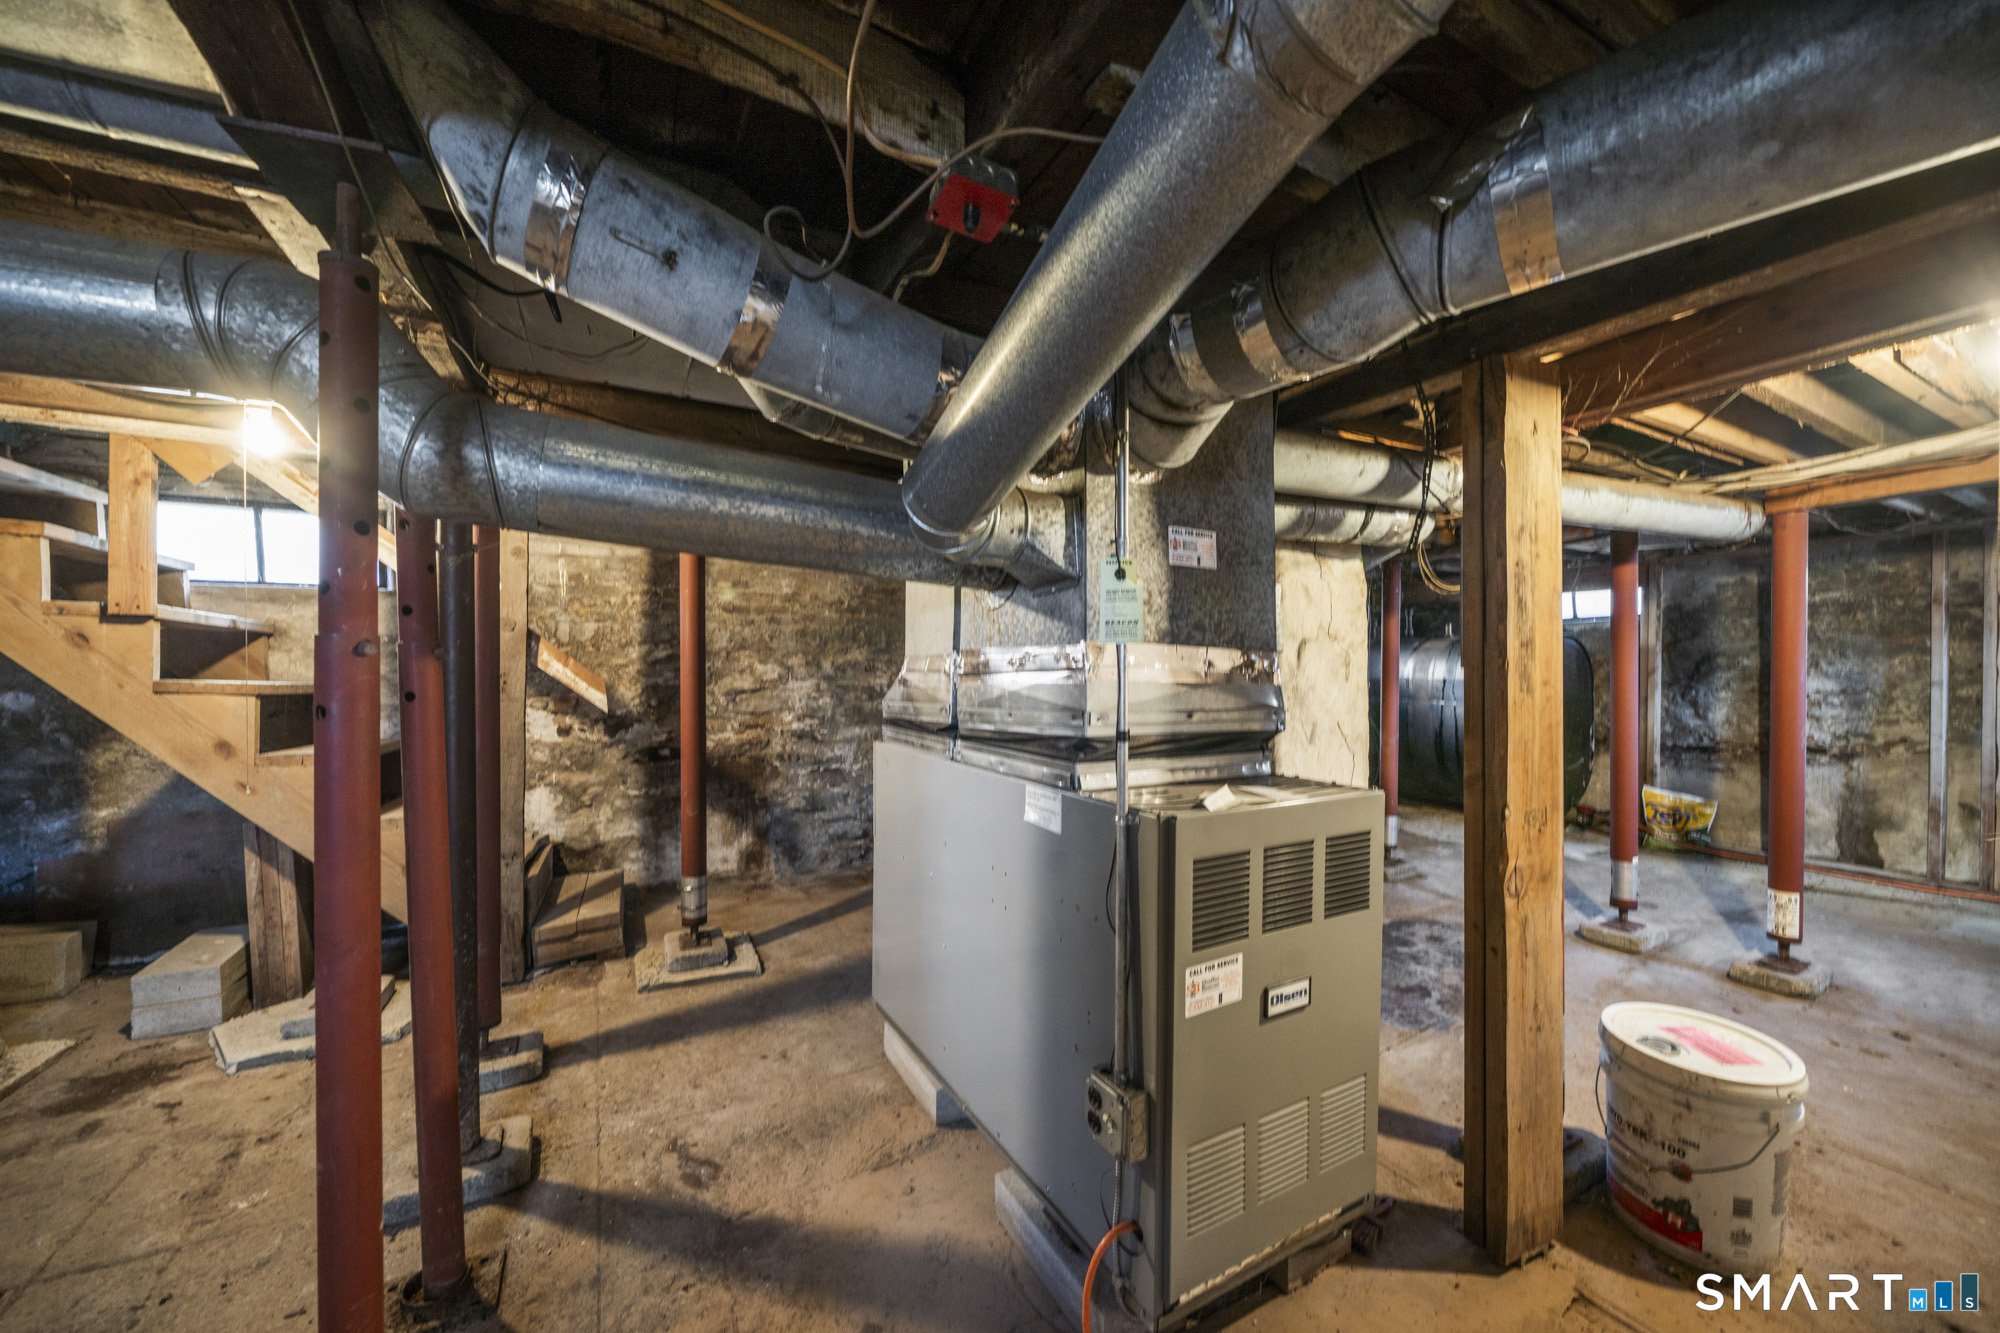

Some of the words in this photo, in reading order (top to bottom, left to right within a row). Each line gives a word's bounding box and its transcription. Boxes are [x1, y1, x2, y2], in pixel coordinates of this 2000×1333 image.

[1189, 968, 1203, 978] CALL
[1204, 963, 1216, 973] FOR
[1217, 956, 1239, 969] SERVICE
[1270, 988, 1308, 1006] Olsen
